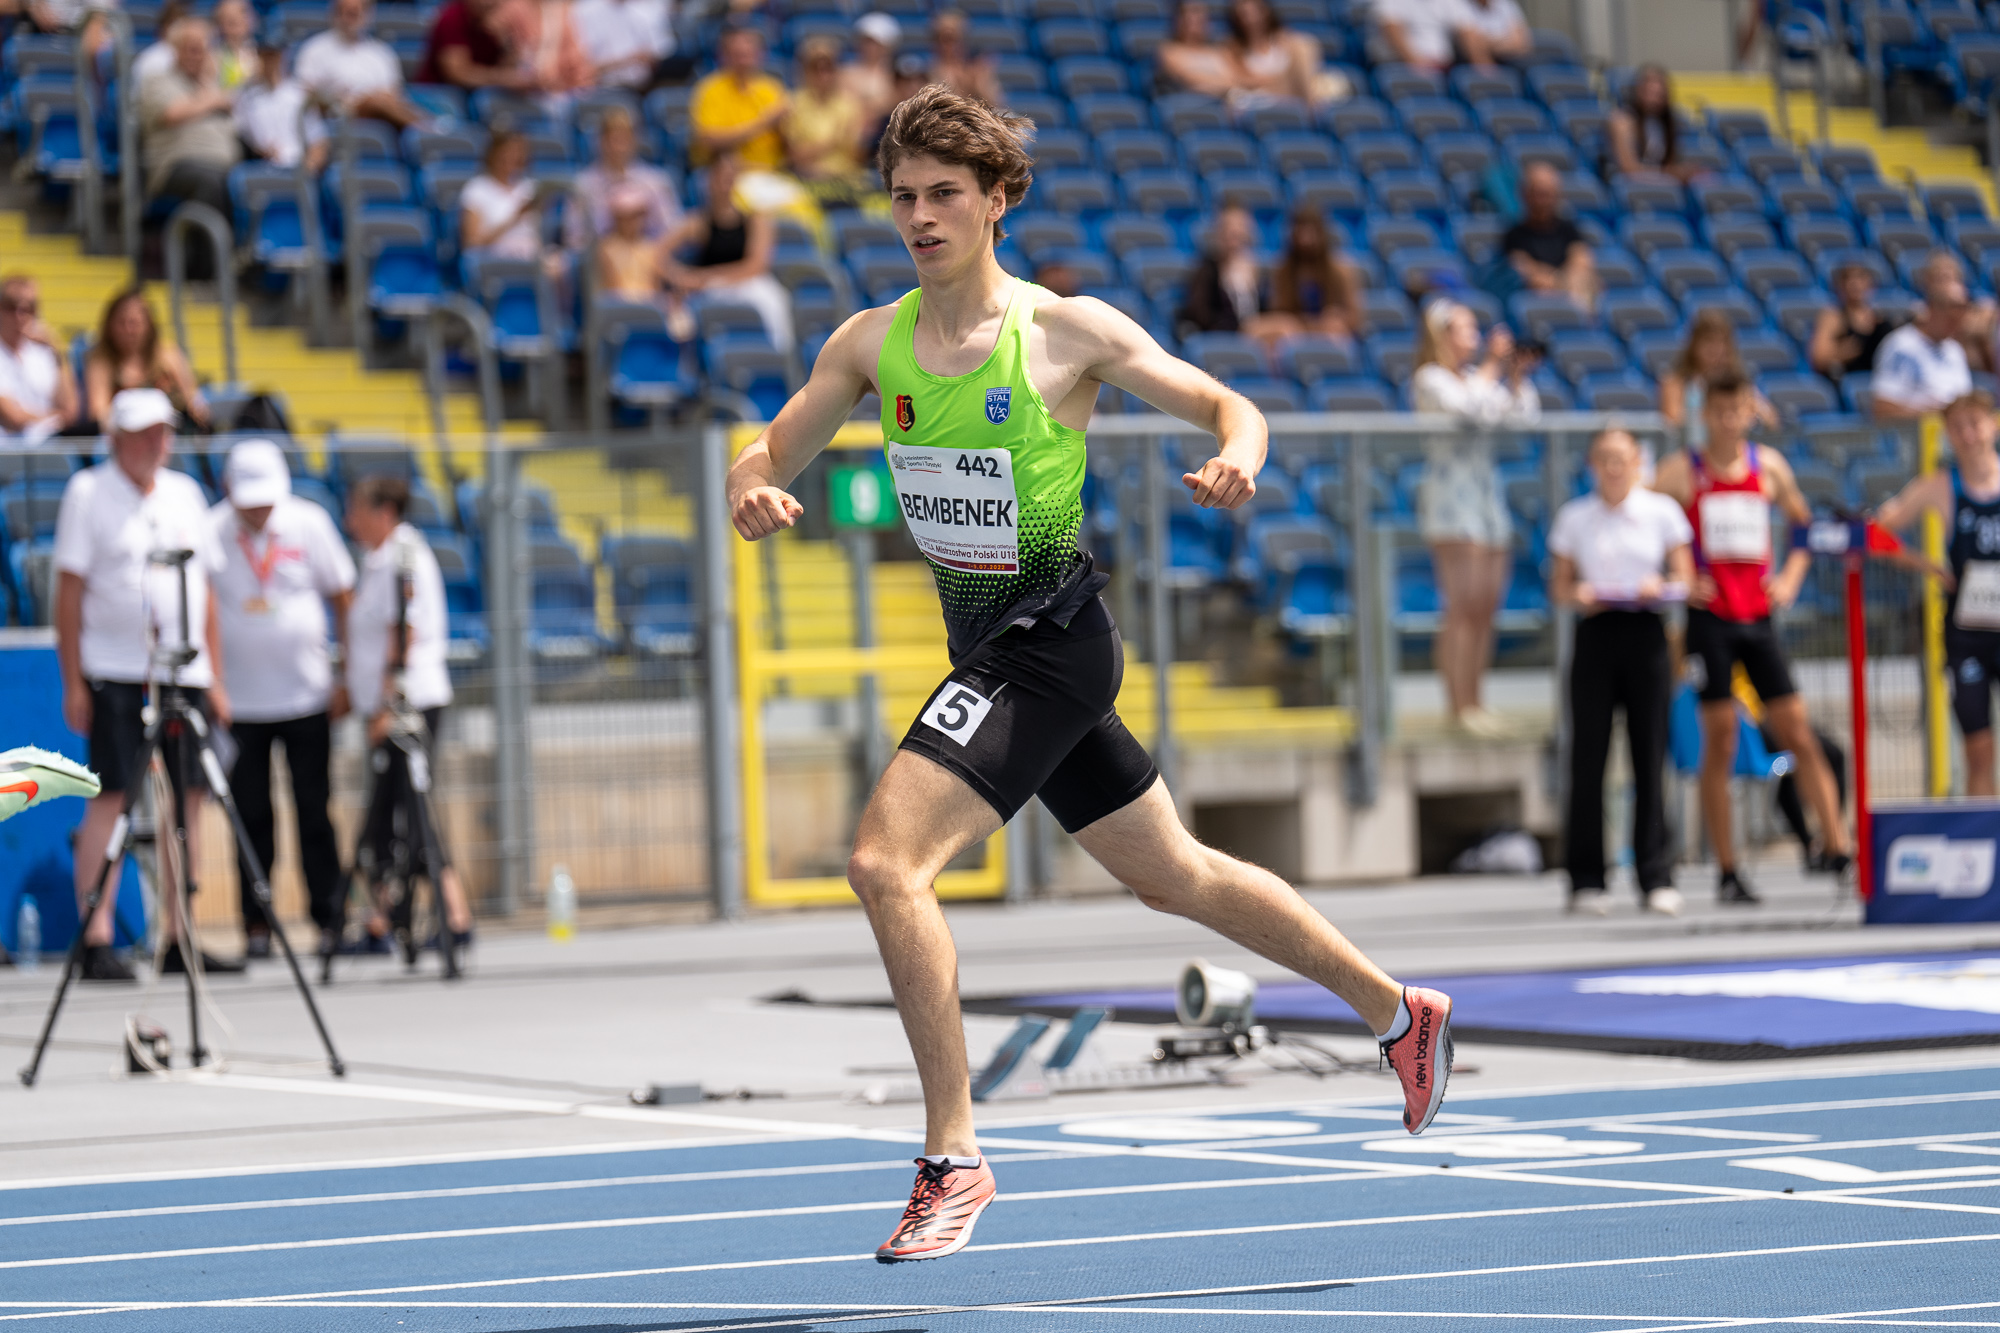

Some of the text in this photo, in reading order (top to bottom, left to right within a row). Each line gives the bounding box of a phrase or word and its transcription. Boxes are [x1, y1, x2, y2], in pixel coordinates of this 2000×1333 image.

[987, 394, 1009, 403] STAL
[955, 453, 1003, 479] 442
[901, 492, 1014, 528] BEMBENEK
[935, 545, 972, 559] Mistrzostwa
[973, 550, 998, 559] Polski
[1000, 550, 1017, 560] U18
[937, 689, 980, 731] 5
[1414, 1006, 1432, 1090] new balance
